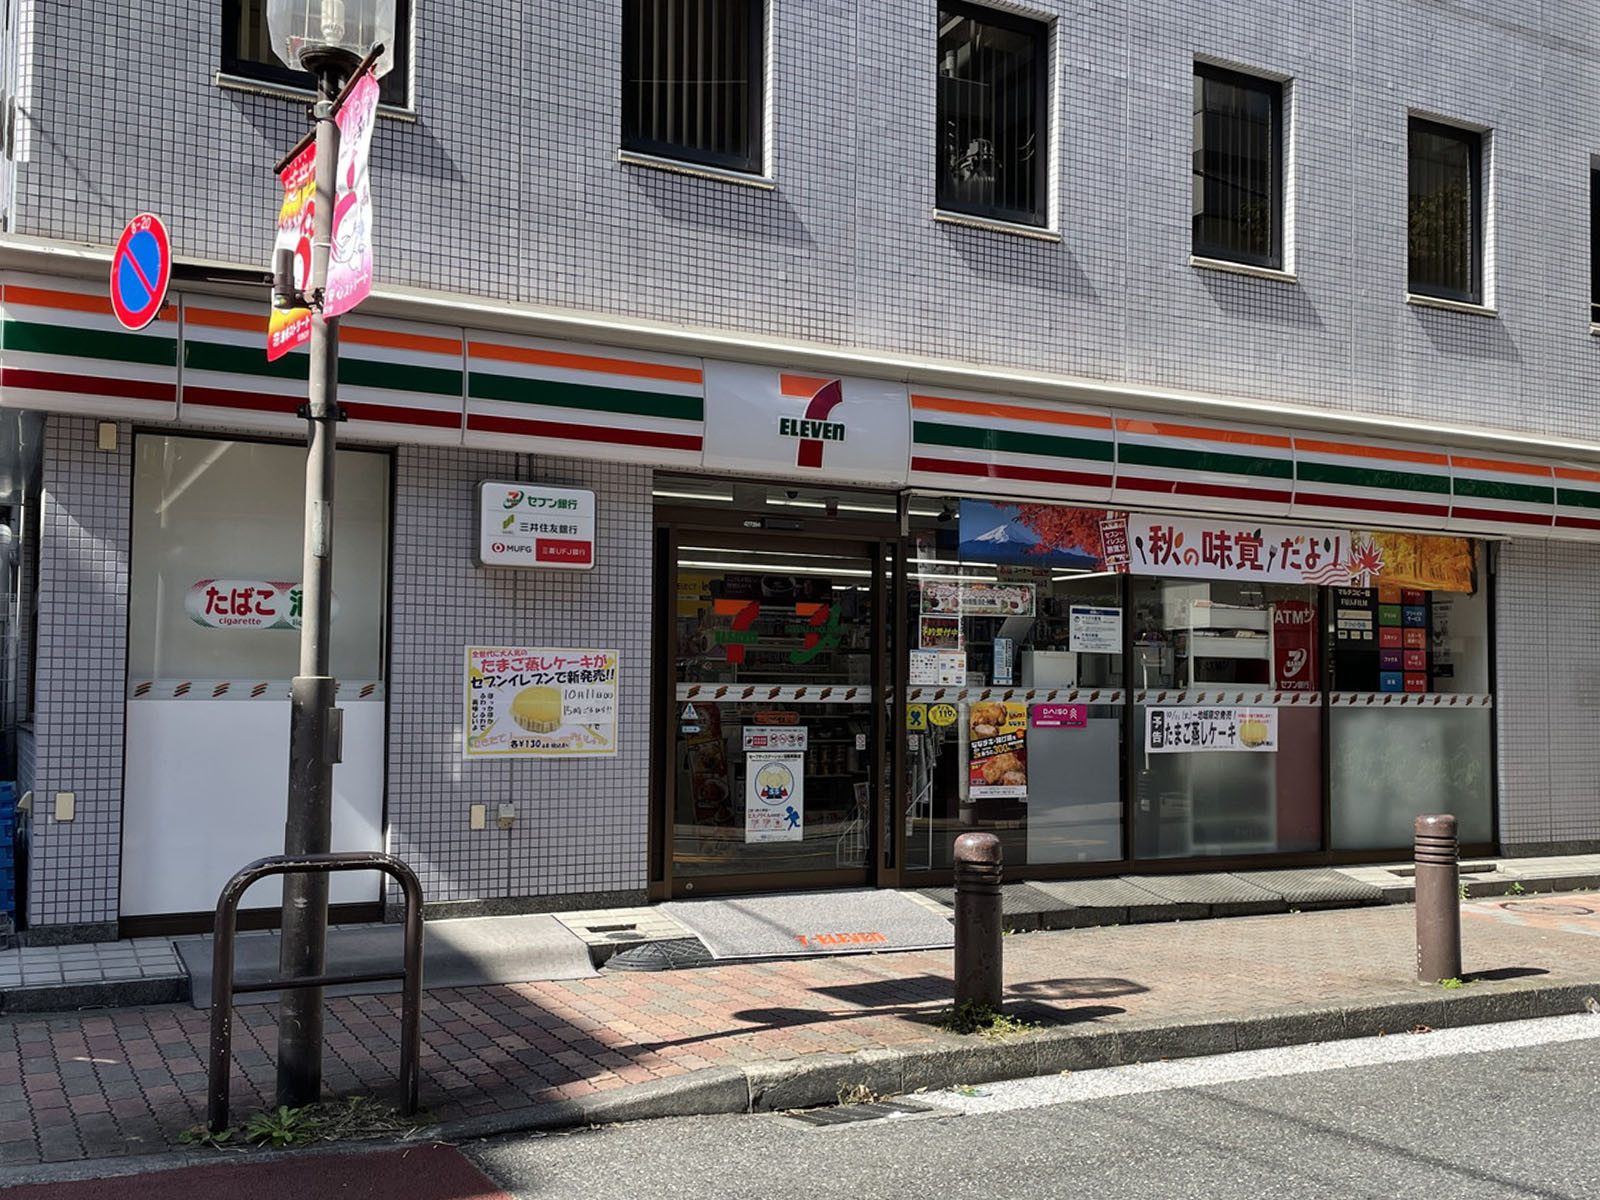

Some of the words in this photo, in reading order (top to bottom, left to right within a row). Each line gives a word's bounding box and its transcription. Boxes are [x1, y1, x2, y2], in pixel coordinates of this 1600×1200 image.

[779, 373, 844, 469] 7
[527, 495, 578, 510] セブン銀行
[519, 521, 578, 535] 三井住友銀行
[506, 544, 532, 553] MUFG
[205, 586, 276, 616] たばこ
[218, 617, 262, 626] cigarette
[1274, 609, 1304, 625] ATM
[481, 655, 608, 673] たまご蒸しケーキが
[1165, 722, 1236, 745] たまご蒸しケーキ
